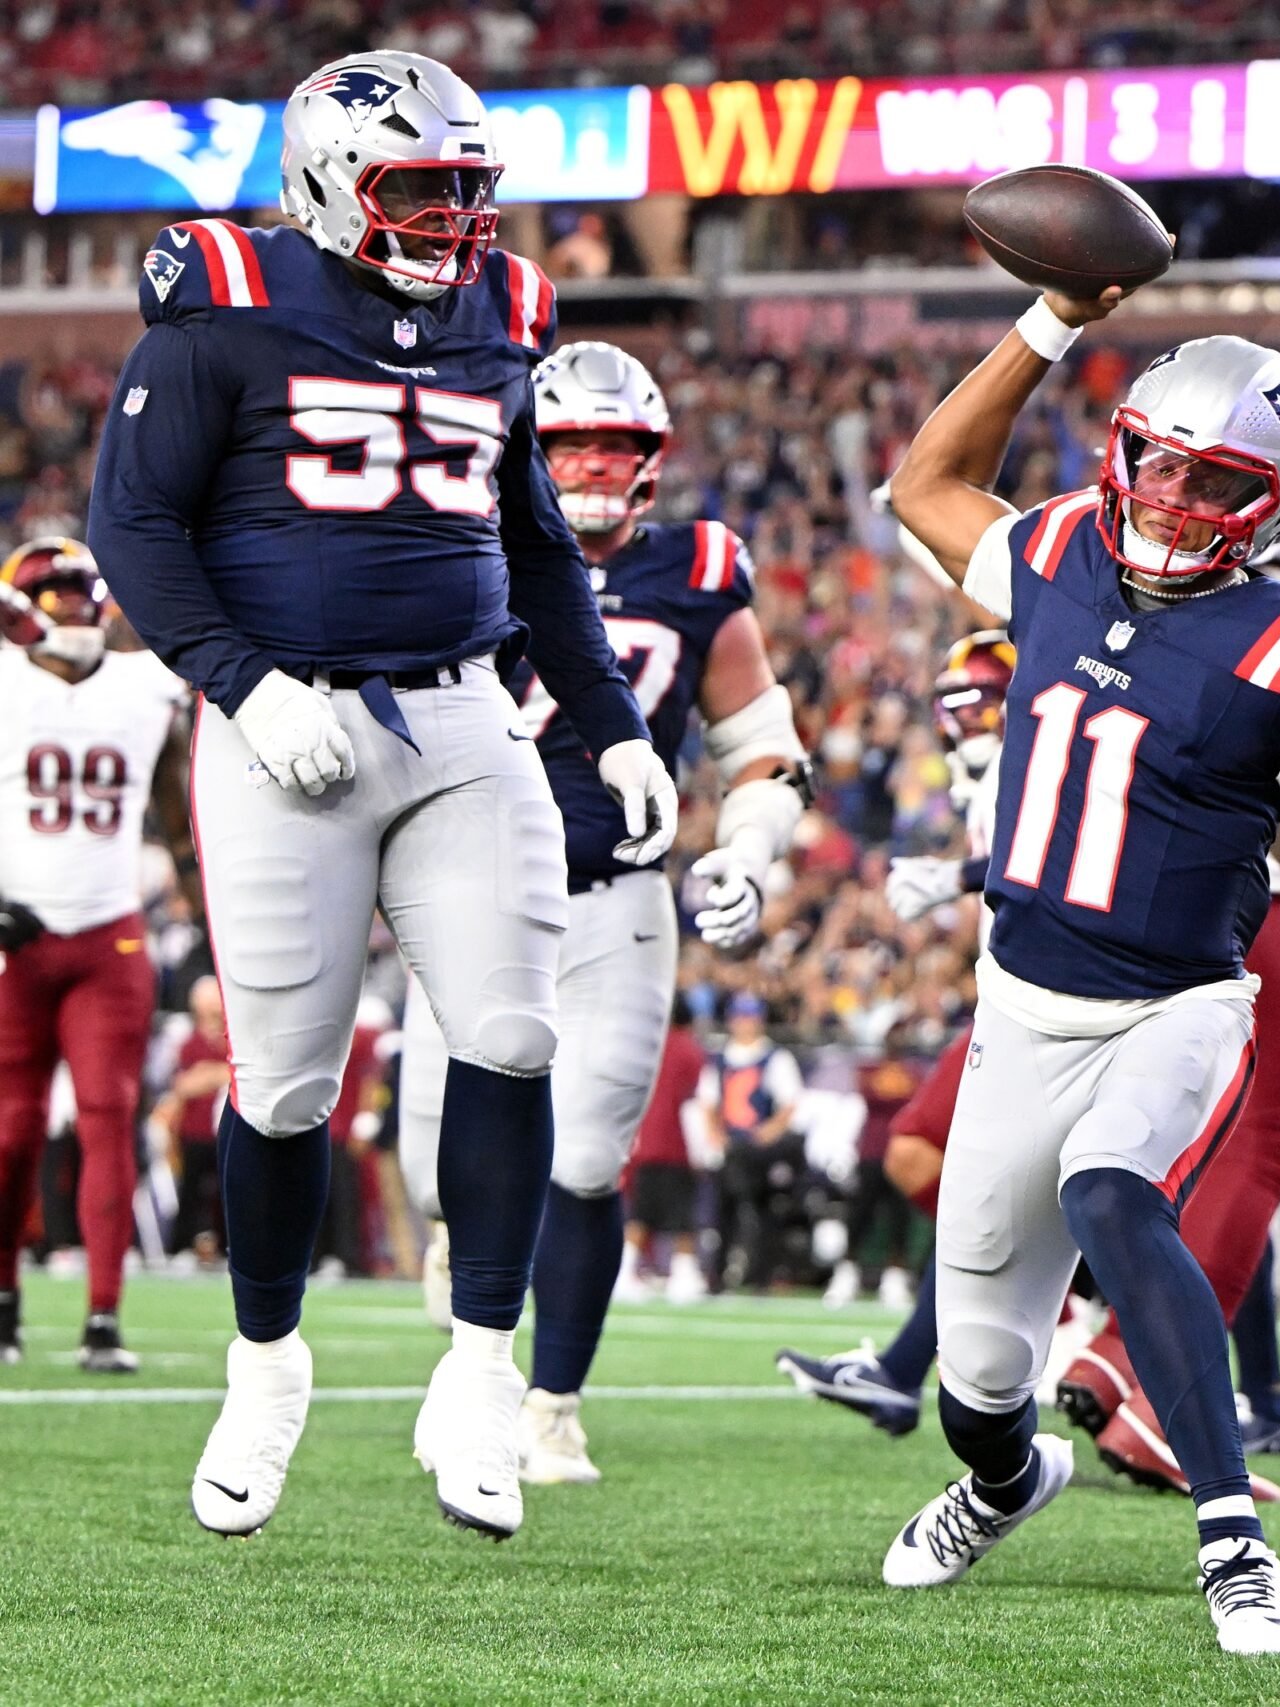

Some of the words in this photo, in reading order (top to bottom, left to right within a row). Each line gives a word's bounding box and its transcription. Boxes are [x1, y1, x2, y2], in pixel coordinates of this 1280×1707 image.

[286, 376, 502, 518] 55
[1073, 655, 1133, 691] PATRIOTS
[26, 741, 128, 837] 99
[1003, 681, 1150, 912] 11
